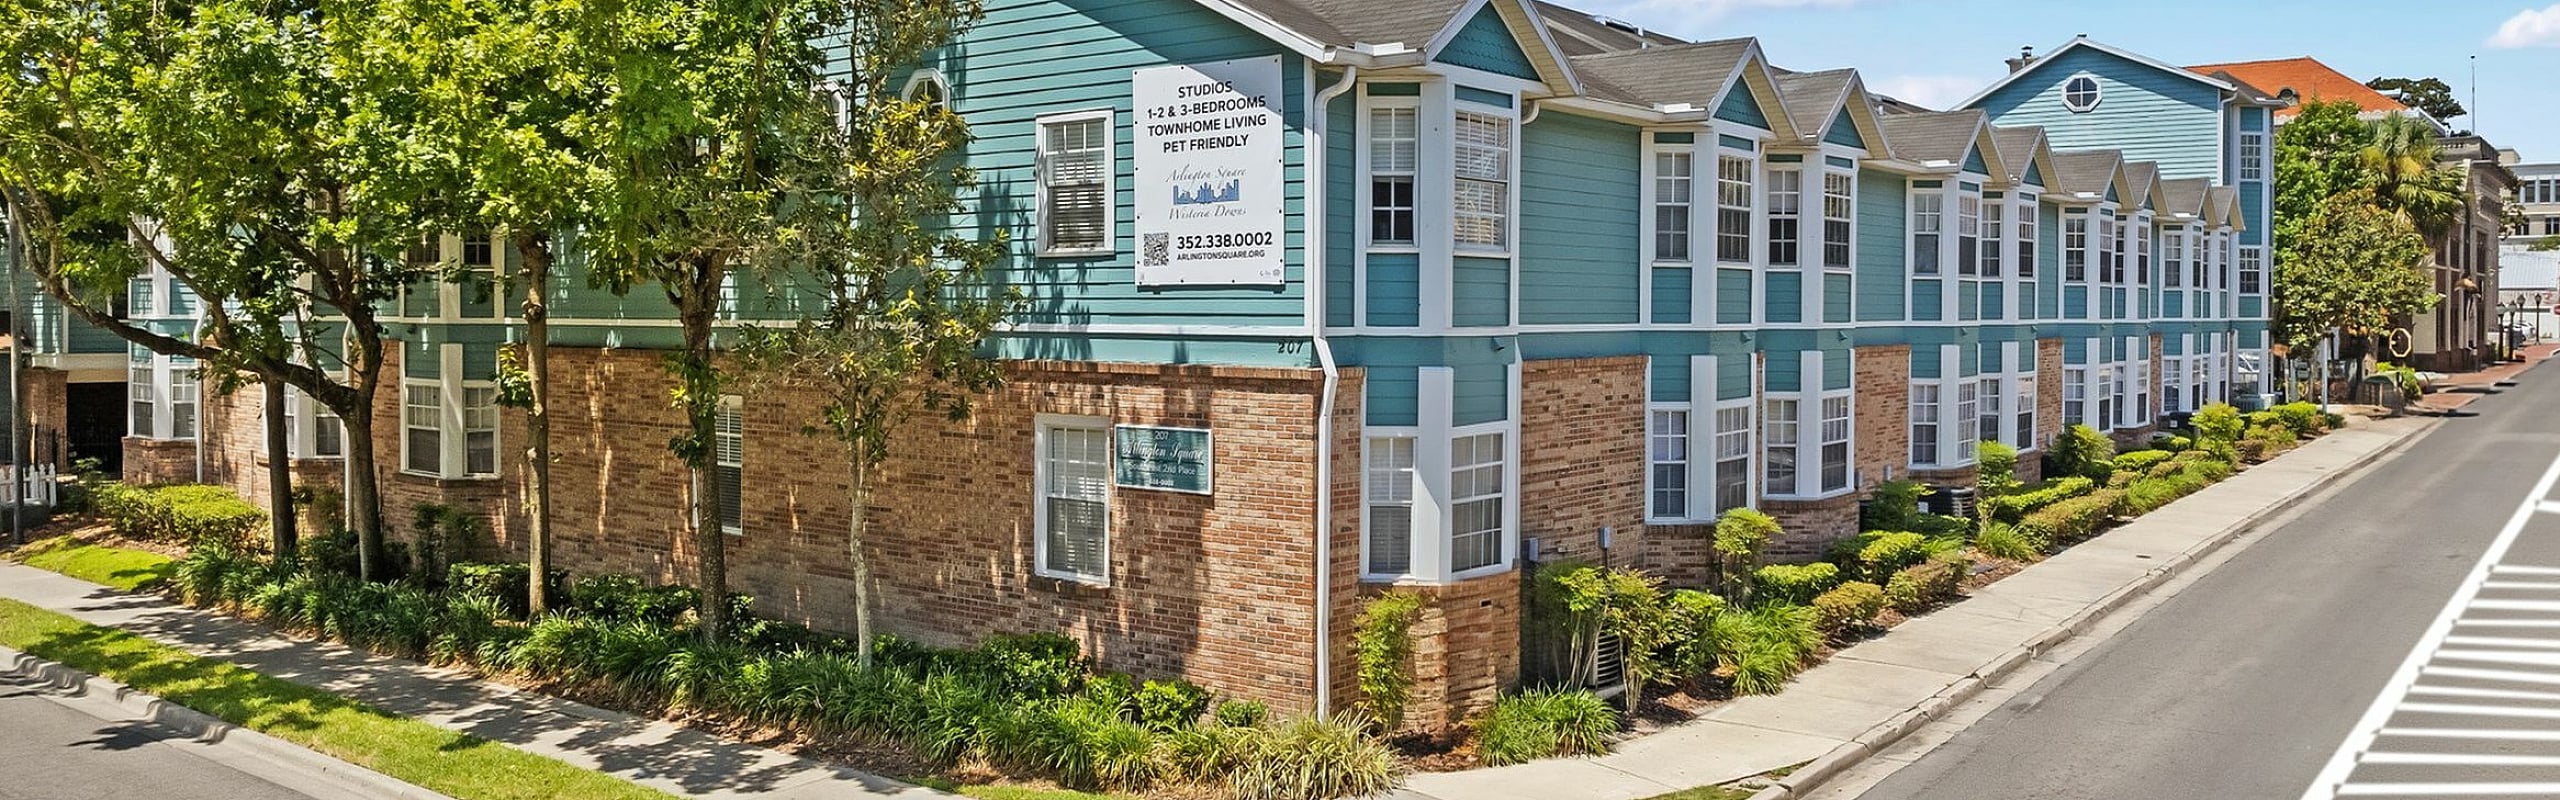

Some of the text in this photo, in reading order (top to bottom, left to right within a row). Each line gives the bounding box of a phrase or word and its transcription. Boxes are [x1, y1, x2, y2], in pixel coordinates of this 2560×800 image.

[1178, 81, 1233, 98] STUDIOS
[1147, 95, 1266, 119] 1-2 & 3-BEDROOMS
[1147, 114, 1267, 137] TOWNHOME LIVING
[1163, 134, 1249, 153] PET FRIENDLY
[1177, 232, 1273, 249] 352.338.0002
[1177, 250, 1265, 261] ARLINGTONSQUARE.ORG
[1277, 340, 1304, 354] 207
[1154, 430, 1169, 441] 207
